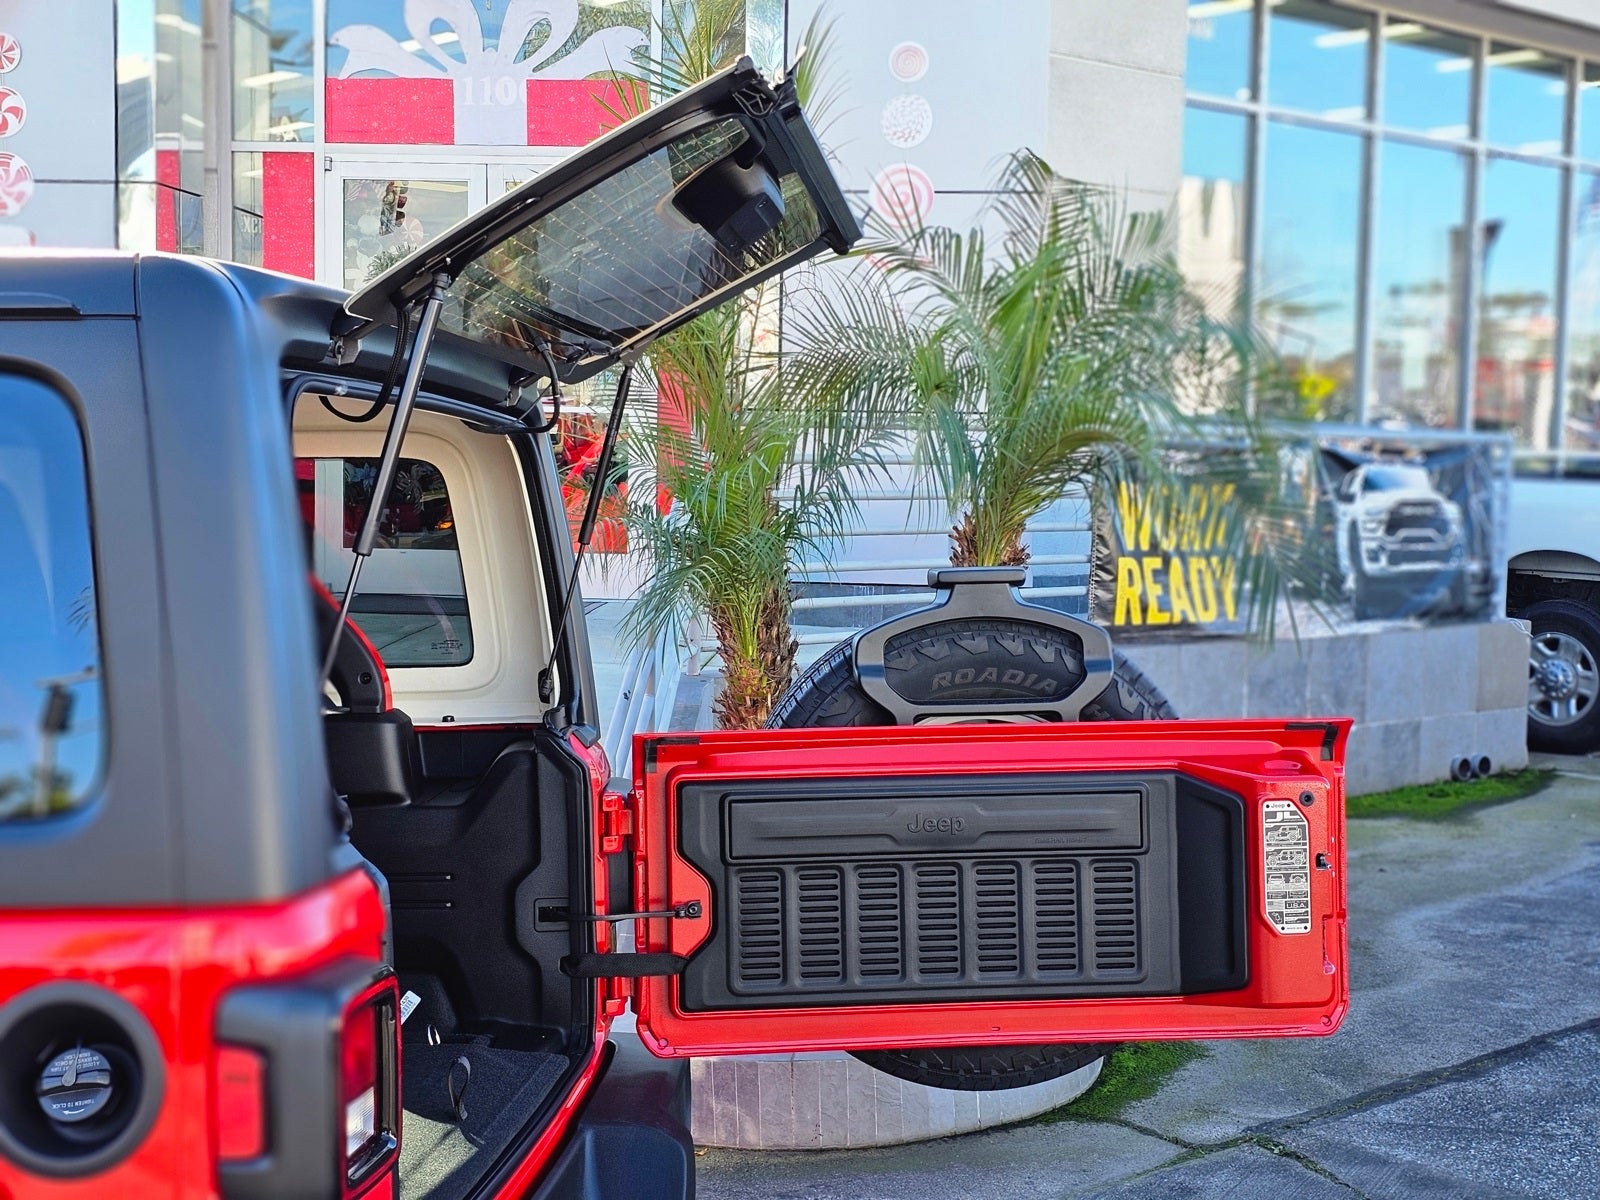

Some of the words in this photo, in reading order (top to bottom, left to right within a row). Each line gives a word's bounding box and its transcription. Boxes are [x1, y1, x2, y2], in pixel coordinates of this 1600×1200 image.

[1114, 556, 1237, 626] READY
[931, 667, 1064, 696] ROADIA
[907, 812, 965, 836] Jeep
